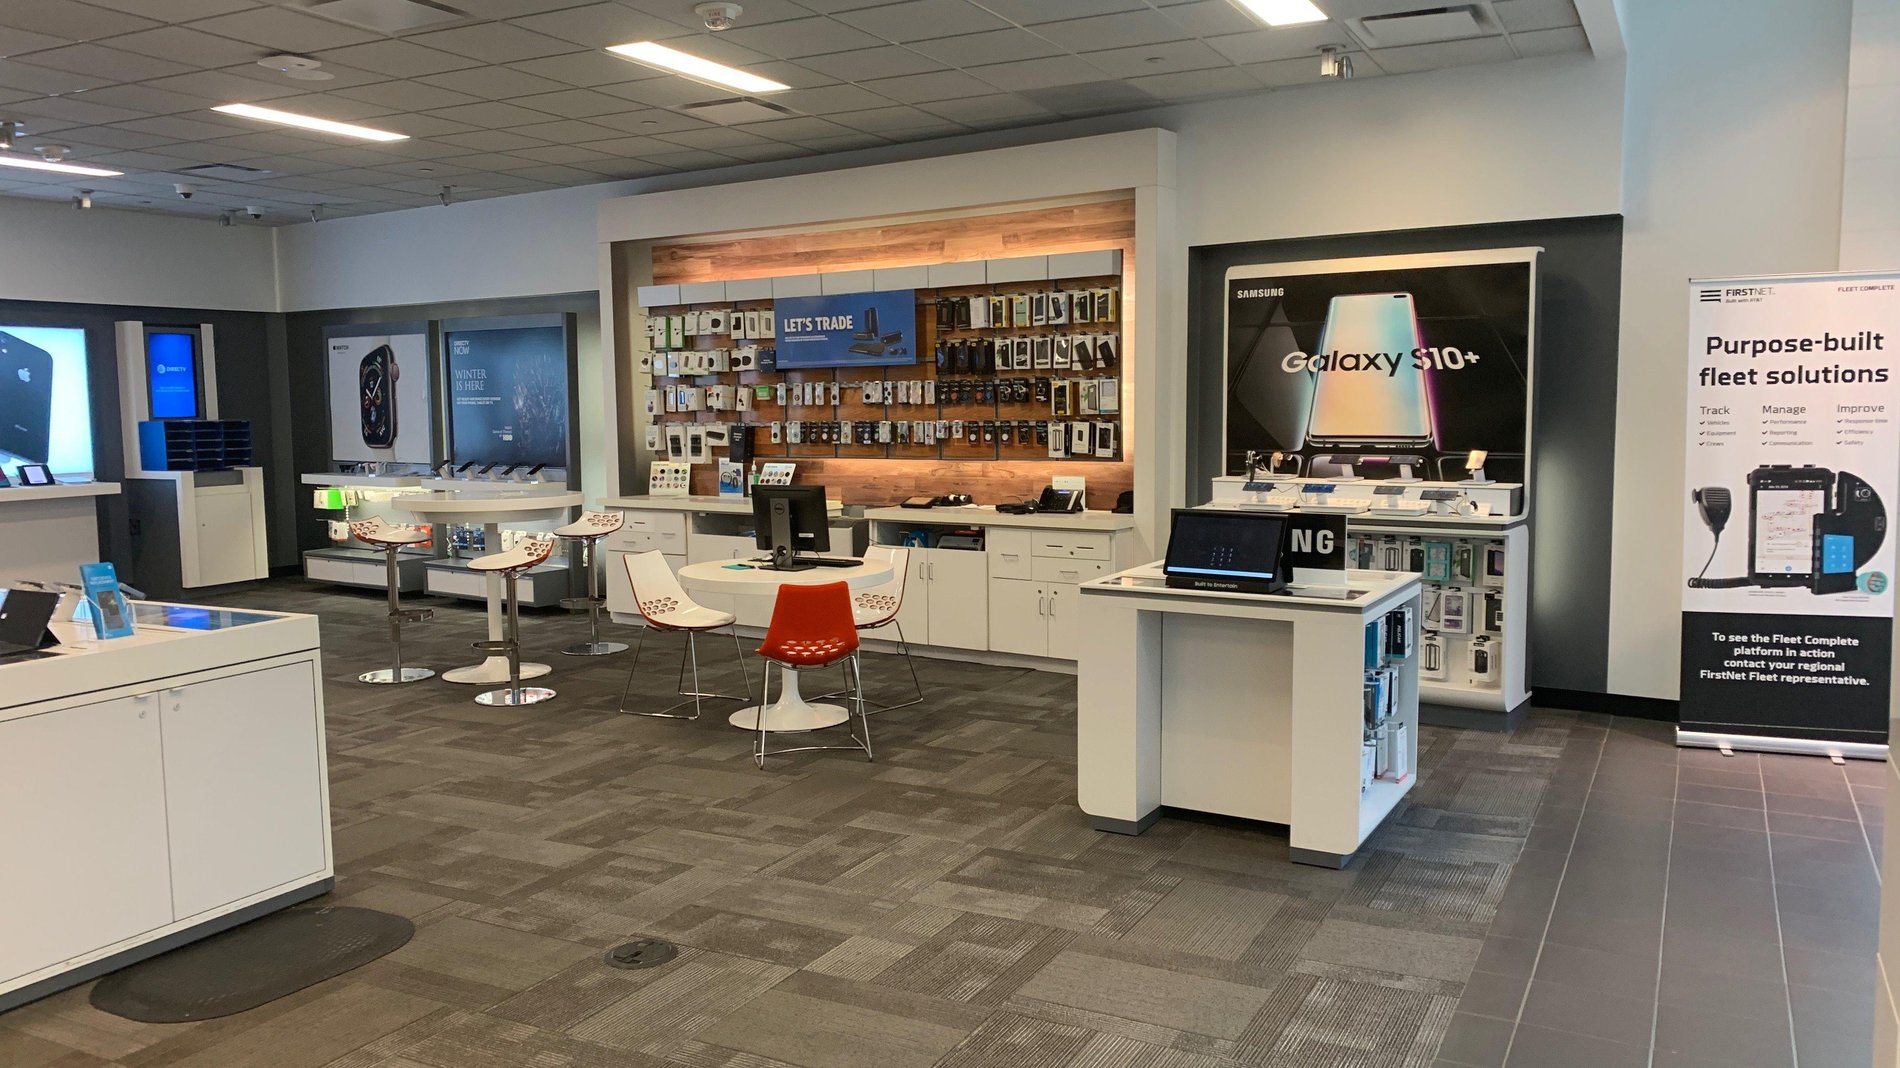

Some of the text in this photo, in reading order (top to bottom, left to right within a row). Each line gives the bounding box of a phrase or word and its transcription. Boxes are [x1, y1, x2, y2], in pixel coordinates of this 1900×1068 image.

[1237, 287, 1284, 299] SAMSUNG
[784, 315, 853, 333] LET'S TRADE
[454, 346, 469, 355] NOW
[1706, 331, 1884, 358] Purpose-built
[1281, 346, 1481, 377] Galaxy S10+
[455, 368, 487, 380] WINTER
[1699, 365, 1889, 386] fleet solutions
[456, 380, 485, 391] IS HERE
[1700, 405, 1730, 415] Track
[1762, 405, 1806, 415] Manage
[1837, 404, 1885, 415] Improve
[1712, 632, 1859, 648] To see the Fleet Complete
[1733, 646, 1836, 659] platform in action
[1724, 659, 1845, 673] contact your regional
[1700, 670, 1870, 686] FirstNet Fleet representative.
